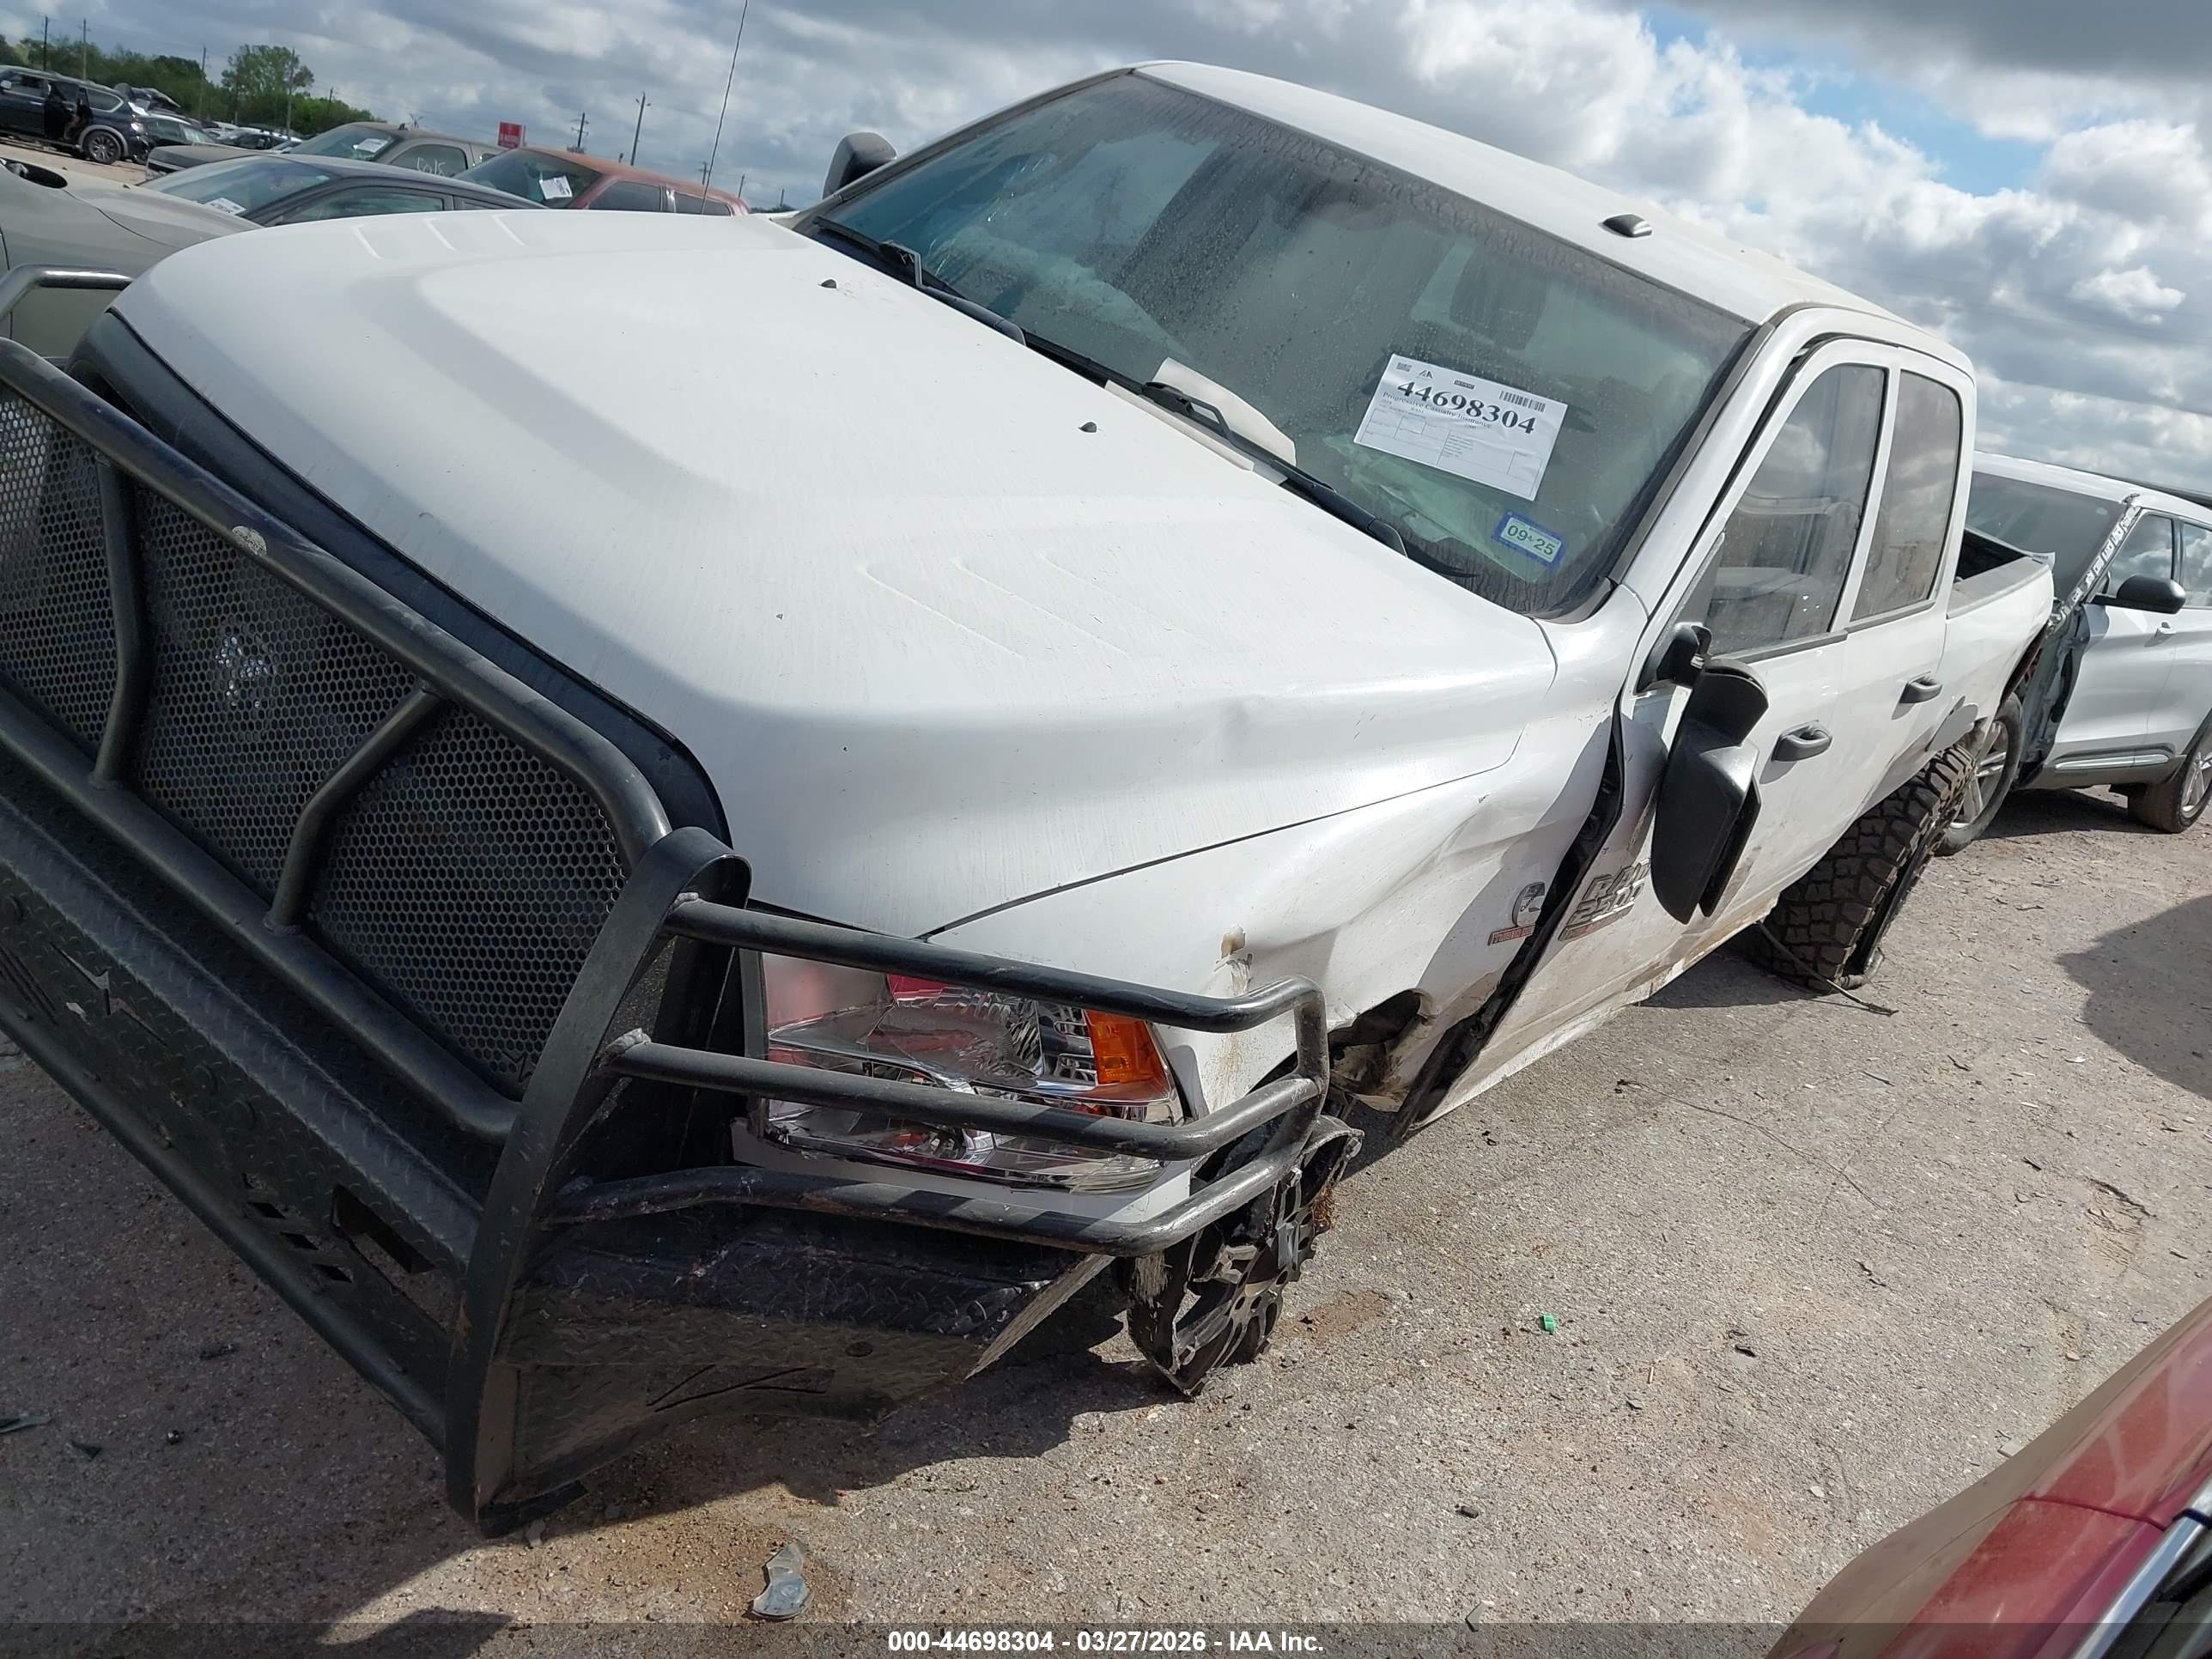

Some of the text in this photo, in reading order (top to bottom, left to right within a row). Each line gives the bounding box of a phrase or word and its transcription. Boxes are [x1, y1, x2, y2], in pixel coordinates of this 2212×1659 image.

[1397, 381, 1535, 434] 44698304
[1508, 526, 1555, 555] 09 25
